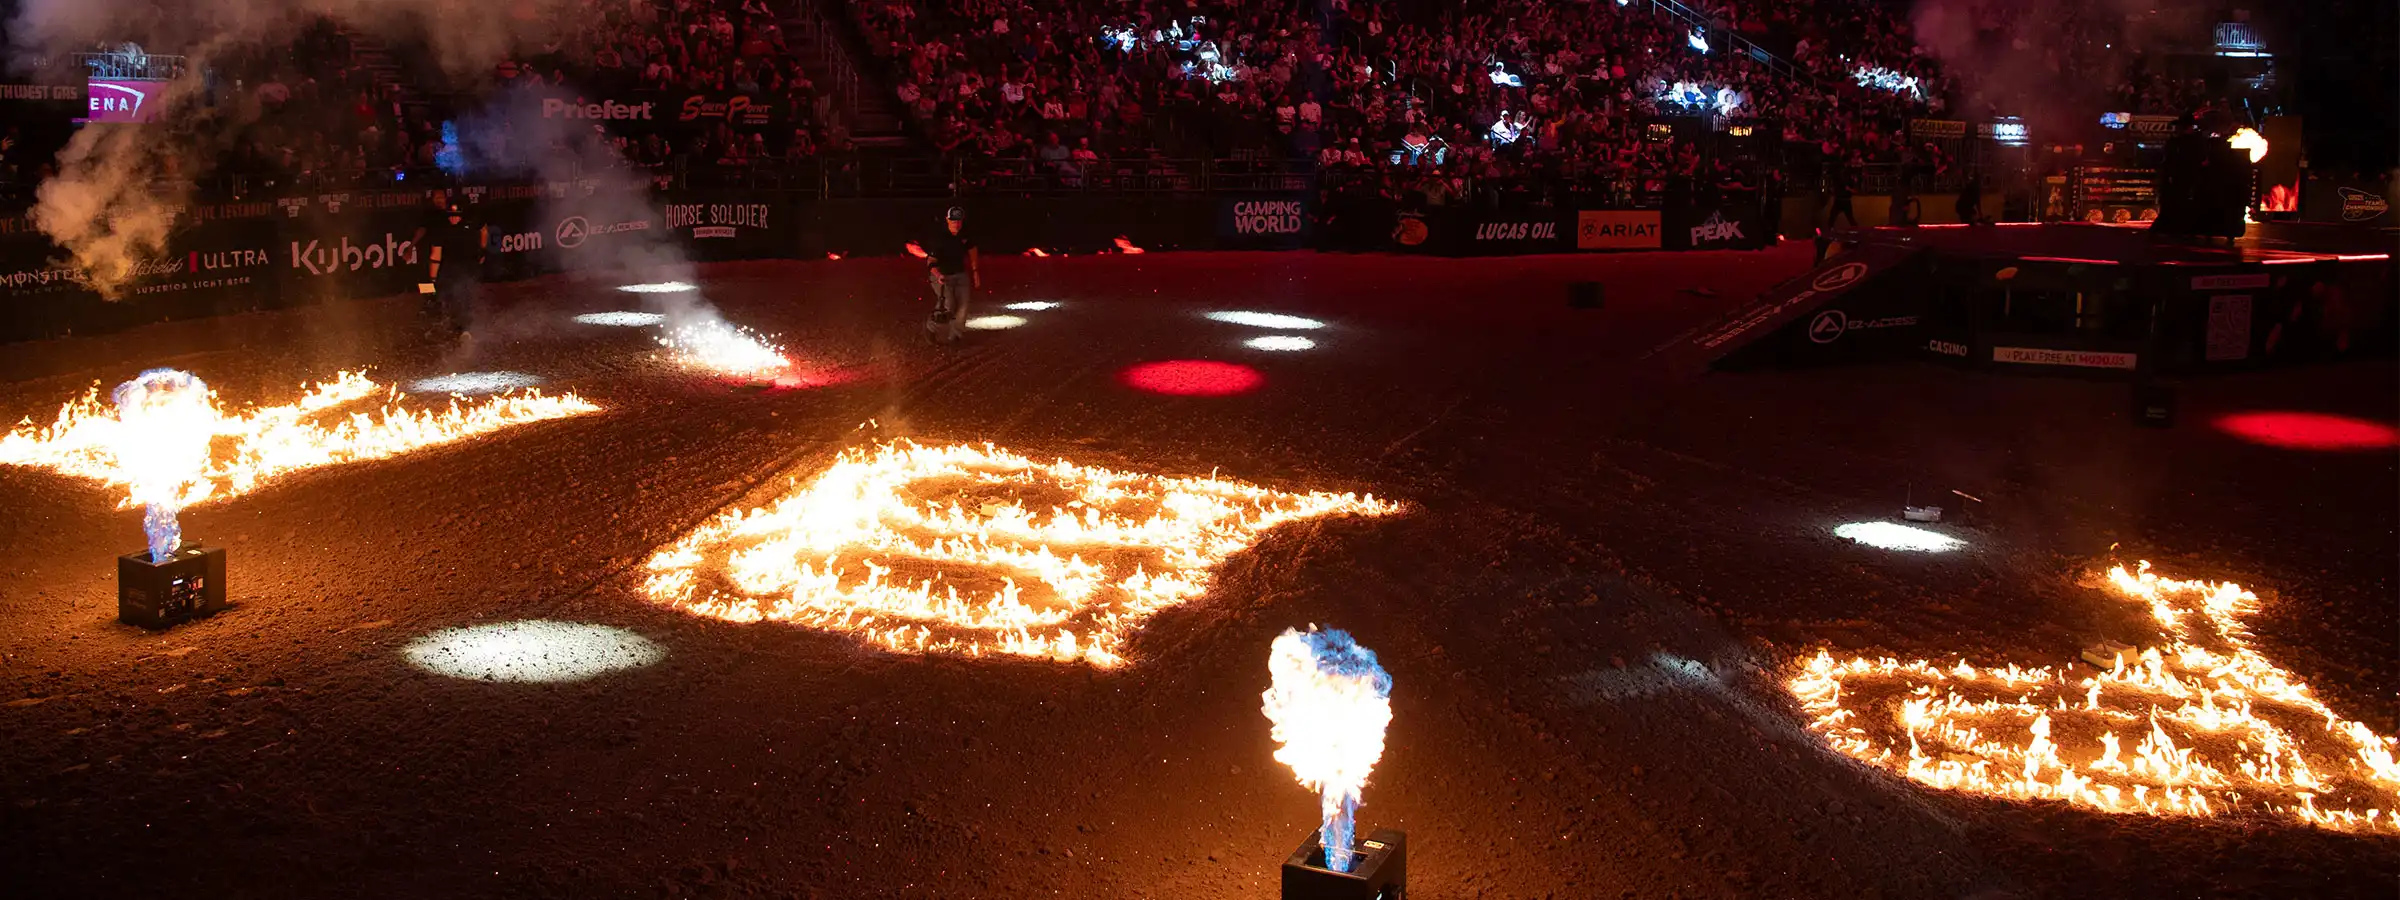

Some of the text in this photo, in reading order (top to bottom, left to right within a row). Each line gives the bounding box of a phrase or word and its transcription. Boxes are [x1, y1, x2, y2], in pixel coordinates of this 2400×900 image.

[53, 86, 77, 99] GAS
[90, 97, 129, 111] ENA
[542, 98, 654, 120] Priefert
[665, 204, 769, 230] HORSE SOLDIER
[1234, 201, 1301, 216] CAMPING
[1235, 215, 1301, 234] WORLD
[1476, 222, 1557, 240] LUCAS OIL
[1600, 224, 1658, 237] ARIAT
[1690, 219, 1747, 246] PEAK
[204, 249, 268, 270] ULTRA
[291, 232, 418, 275] Kubota
[136, 283, 187, 295] SUPERIOR
[193, 279, 223, 289] LIGHT
[1929, 339, 1968, 357] CASINO
[2013, 350, 2036, 361] PLAY
